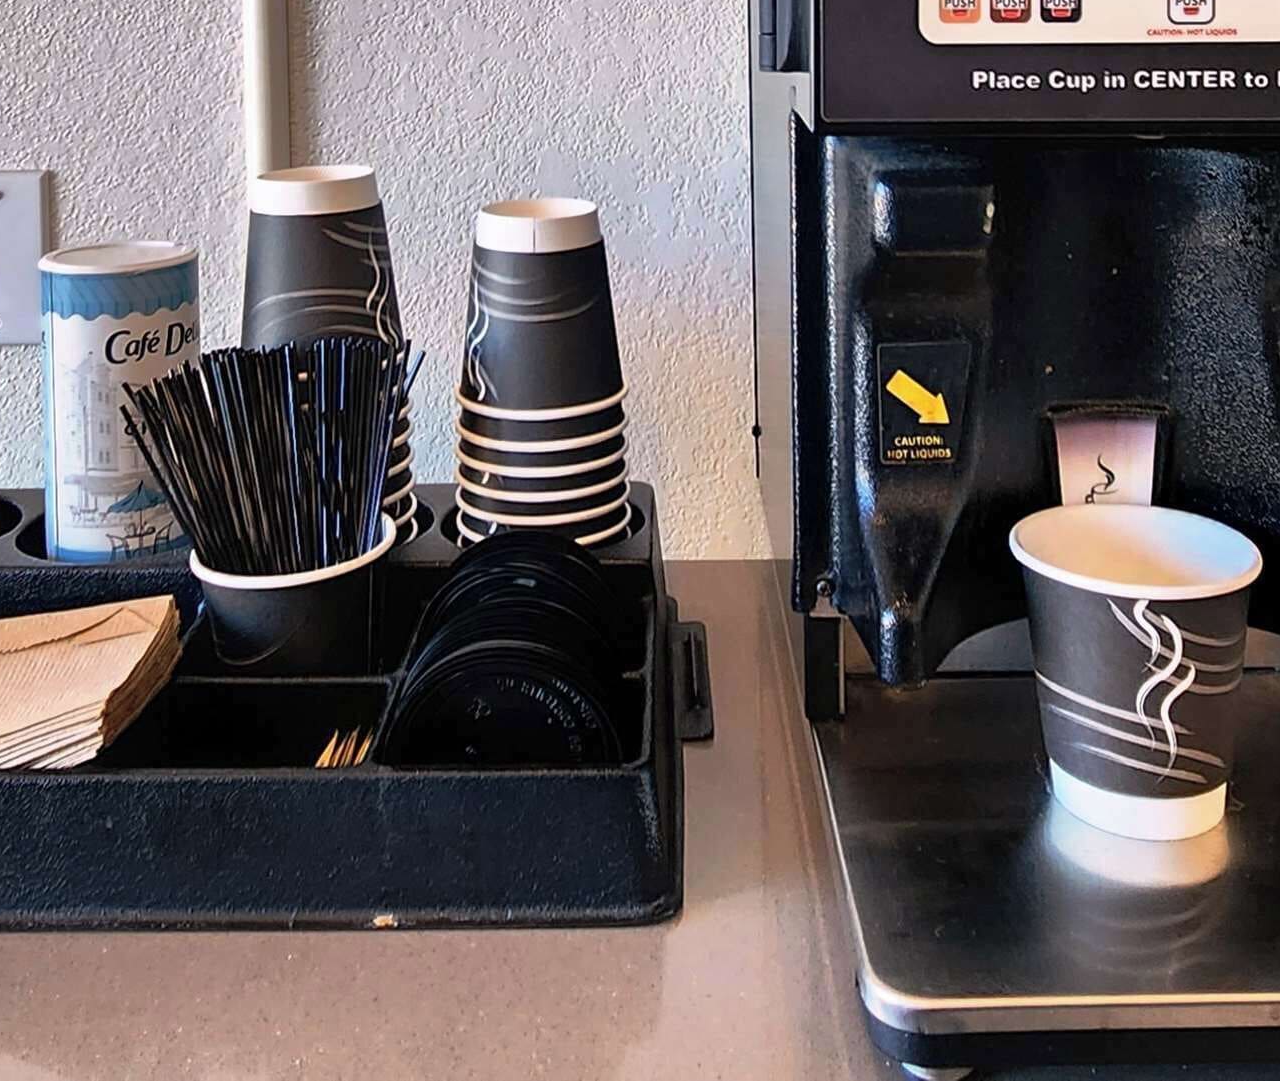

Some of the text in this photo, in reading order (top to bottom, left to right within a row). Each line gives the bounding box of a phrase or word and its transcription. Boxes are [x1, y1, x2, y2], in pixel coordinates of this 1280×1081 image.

[971, 70, 1041, 90] Place
[1048, 70, 1096, 92] Cup
[1104, 70, 1126, 88] in
[1134, 70, 1236, 89] CENTER
[1244, 71, 1269, 88] to
[105, 330, 161, 365] Café
[887, 447, 952, 459] HOT LIQUIDS
